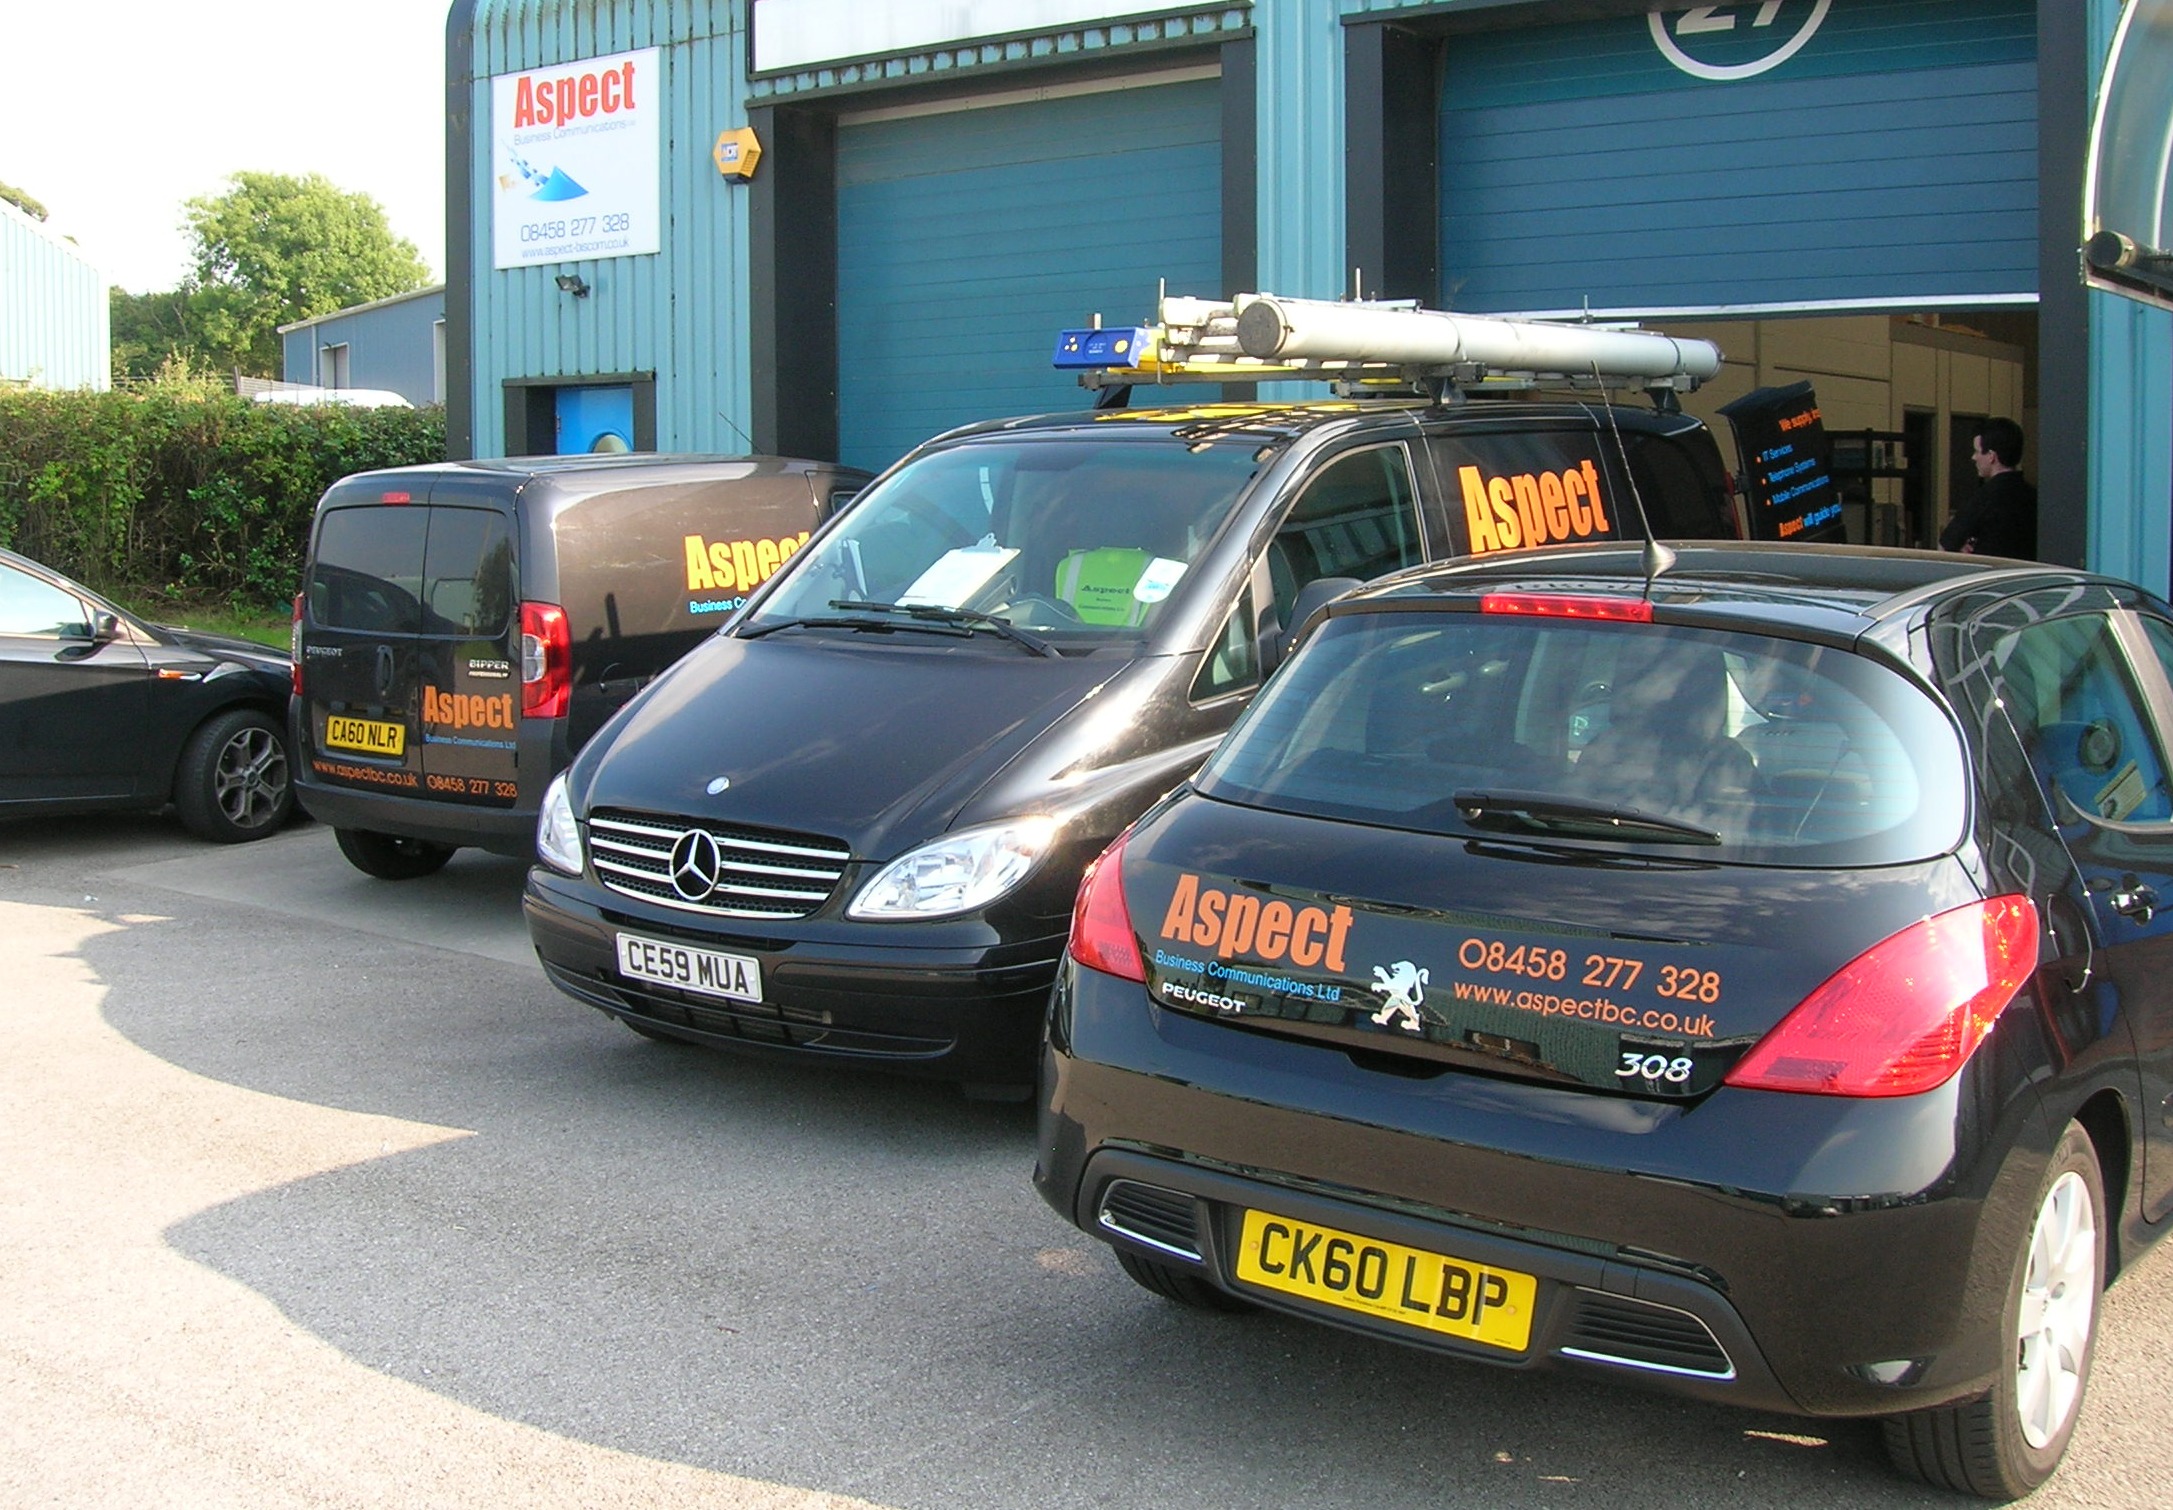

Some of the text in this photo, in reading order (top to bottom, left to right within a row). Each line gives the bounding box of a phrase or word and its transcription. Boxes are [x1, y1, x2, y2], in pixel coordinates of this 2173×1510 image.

[514, 61, 635, 128] Aspect
[514, 131, 552, 146] Business
[553, 120, 626, 140] Communications
[520, 213, 630, 242] 08458 277 328
[1459, 459, 1609, 551] Aspect
[684, 531, 810, 592] Aspe
[690, 599, 732, 613] Business
[469, 659, 509, 670] BIPPER
[423, 685, 514, 730] Aspect
[332, 720, 398, 749] CA60 NLR
[425, 733, 517, 751] Business Communications Ltd
[311, 760, 419, 788] www.aspectbc.co.uk
[426, 775, 518, 798] 08458 277 328
[1161, 873, 1354, 973] Aspect
[627, 940, 750, 994] CE59 MUA
[1156, 949, 1341, 1002] Business Communications Ltd
[1458, 938, 1721, 1004] 08458 277 328
[1162, 982, 1246, 1013] PEUGEOT
[1454, 982, 1716, 1038] www.aspectbc.co.uk
[1614, 1052, 1694, 1083] 308
[1258, 1222, 1508, 1327] CK60 LBP
